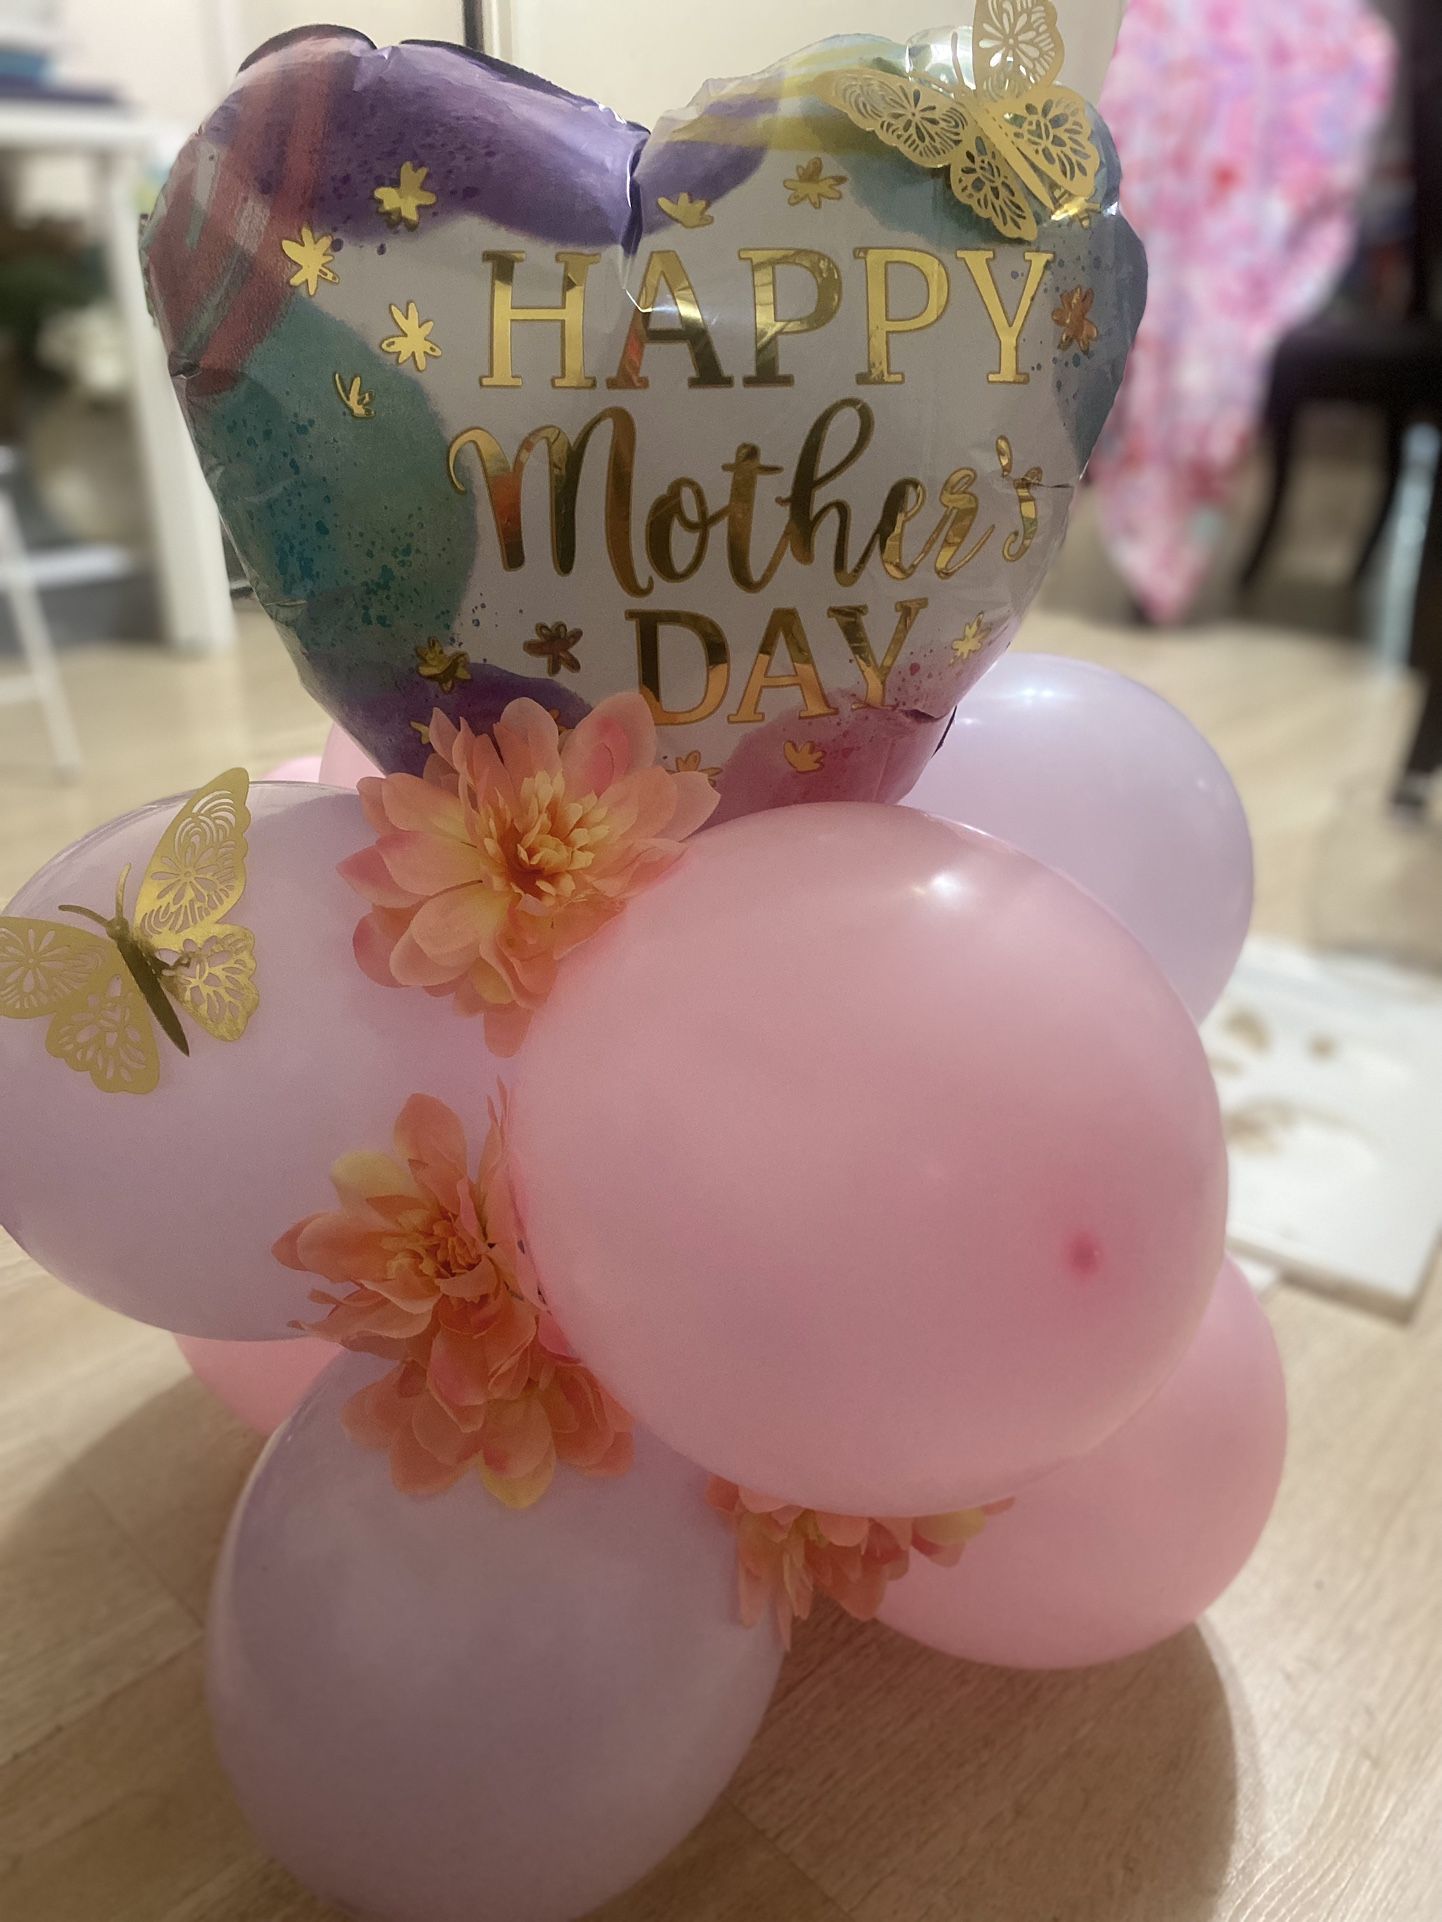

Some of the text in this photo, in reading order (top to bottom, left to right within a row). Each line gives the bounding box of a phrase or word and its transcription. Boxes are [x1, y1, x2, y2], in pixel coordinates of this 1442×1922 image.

[479, 247, 1055, 389] HAPPY
[448, 397, 1044, 597] Mother's
[625, 598, 929, 726] DAY
